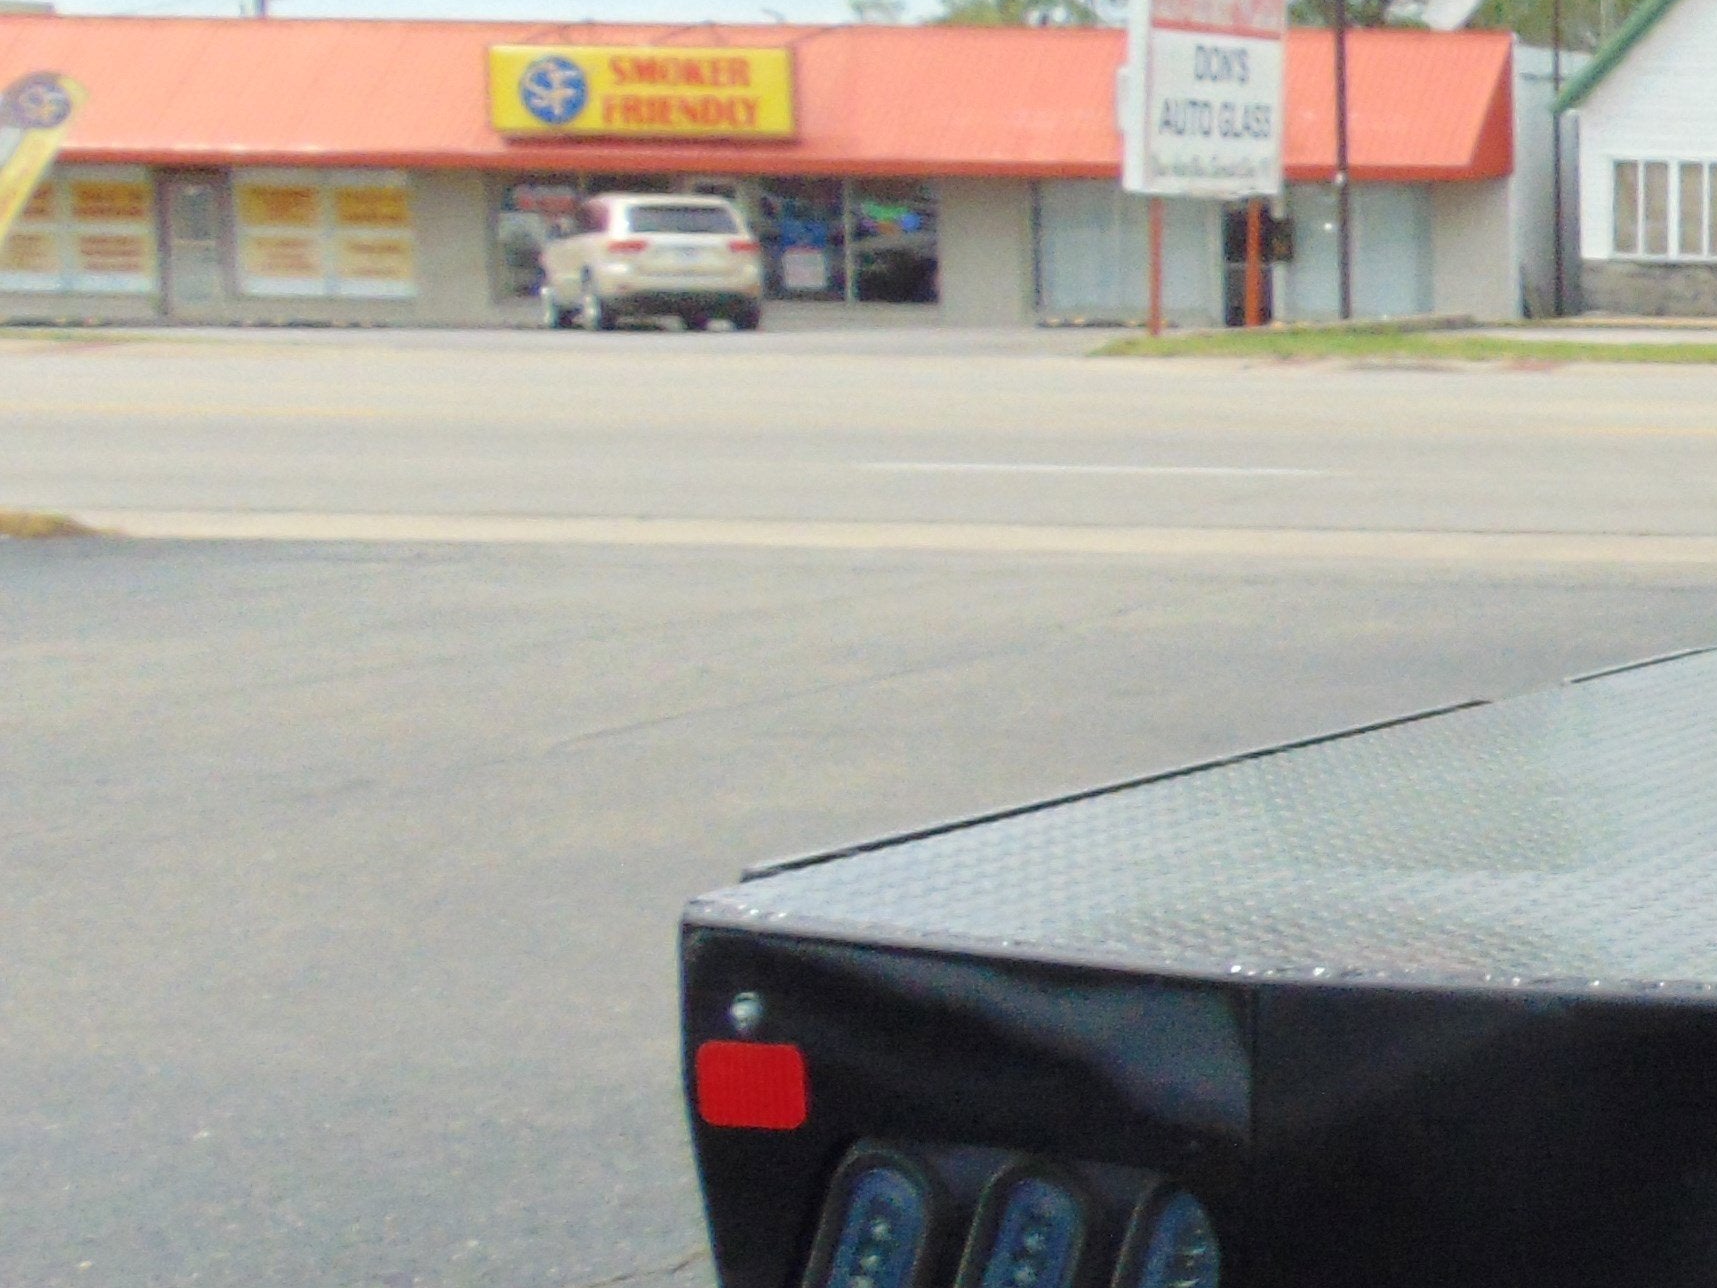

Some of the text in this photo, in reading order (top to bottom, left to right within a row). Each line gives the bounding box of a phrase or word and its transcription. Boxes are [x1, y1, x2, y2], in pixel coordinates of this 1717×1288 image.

[608, 56, 751, 86] SMOKER
[603, 94, 758, 128] FRIENDLY
[1159, 97, 1212, 138] AUTO
